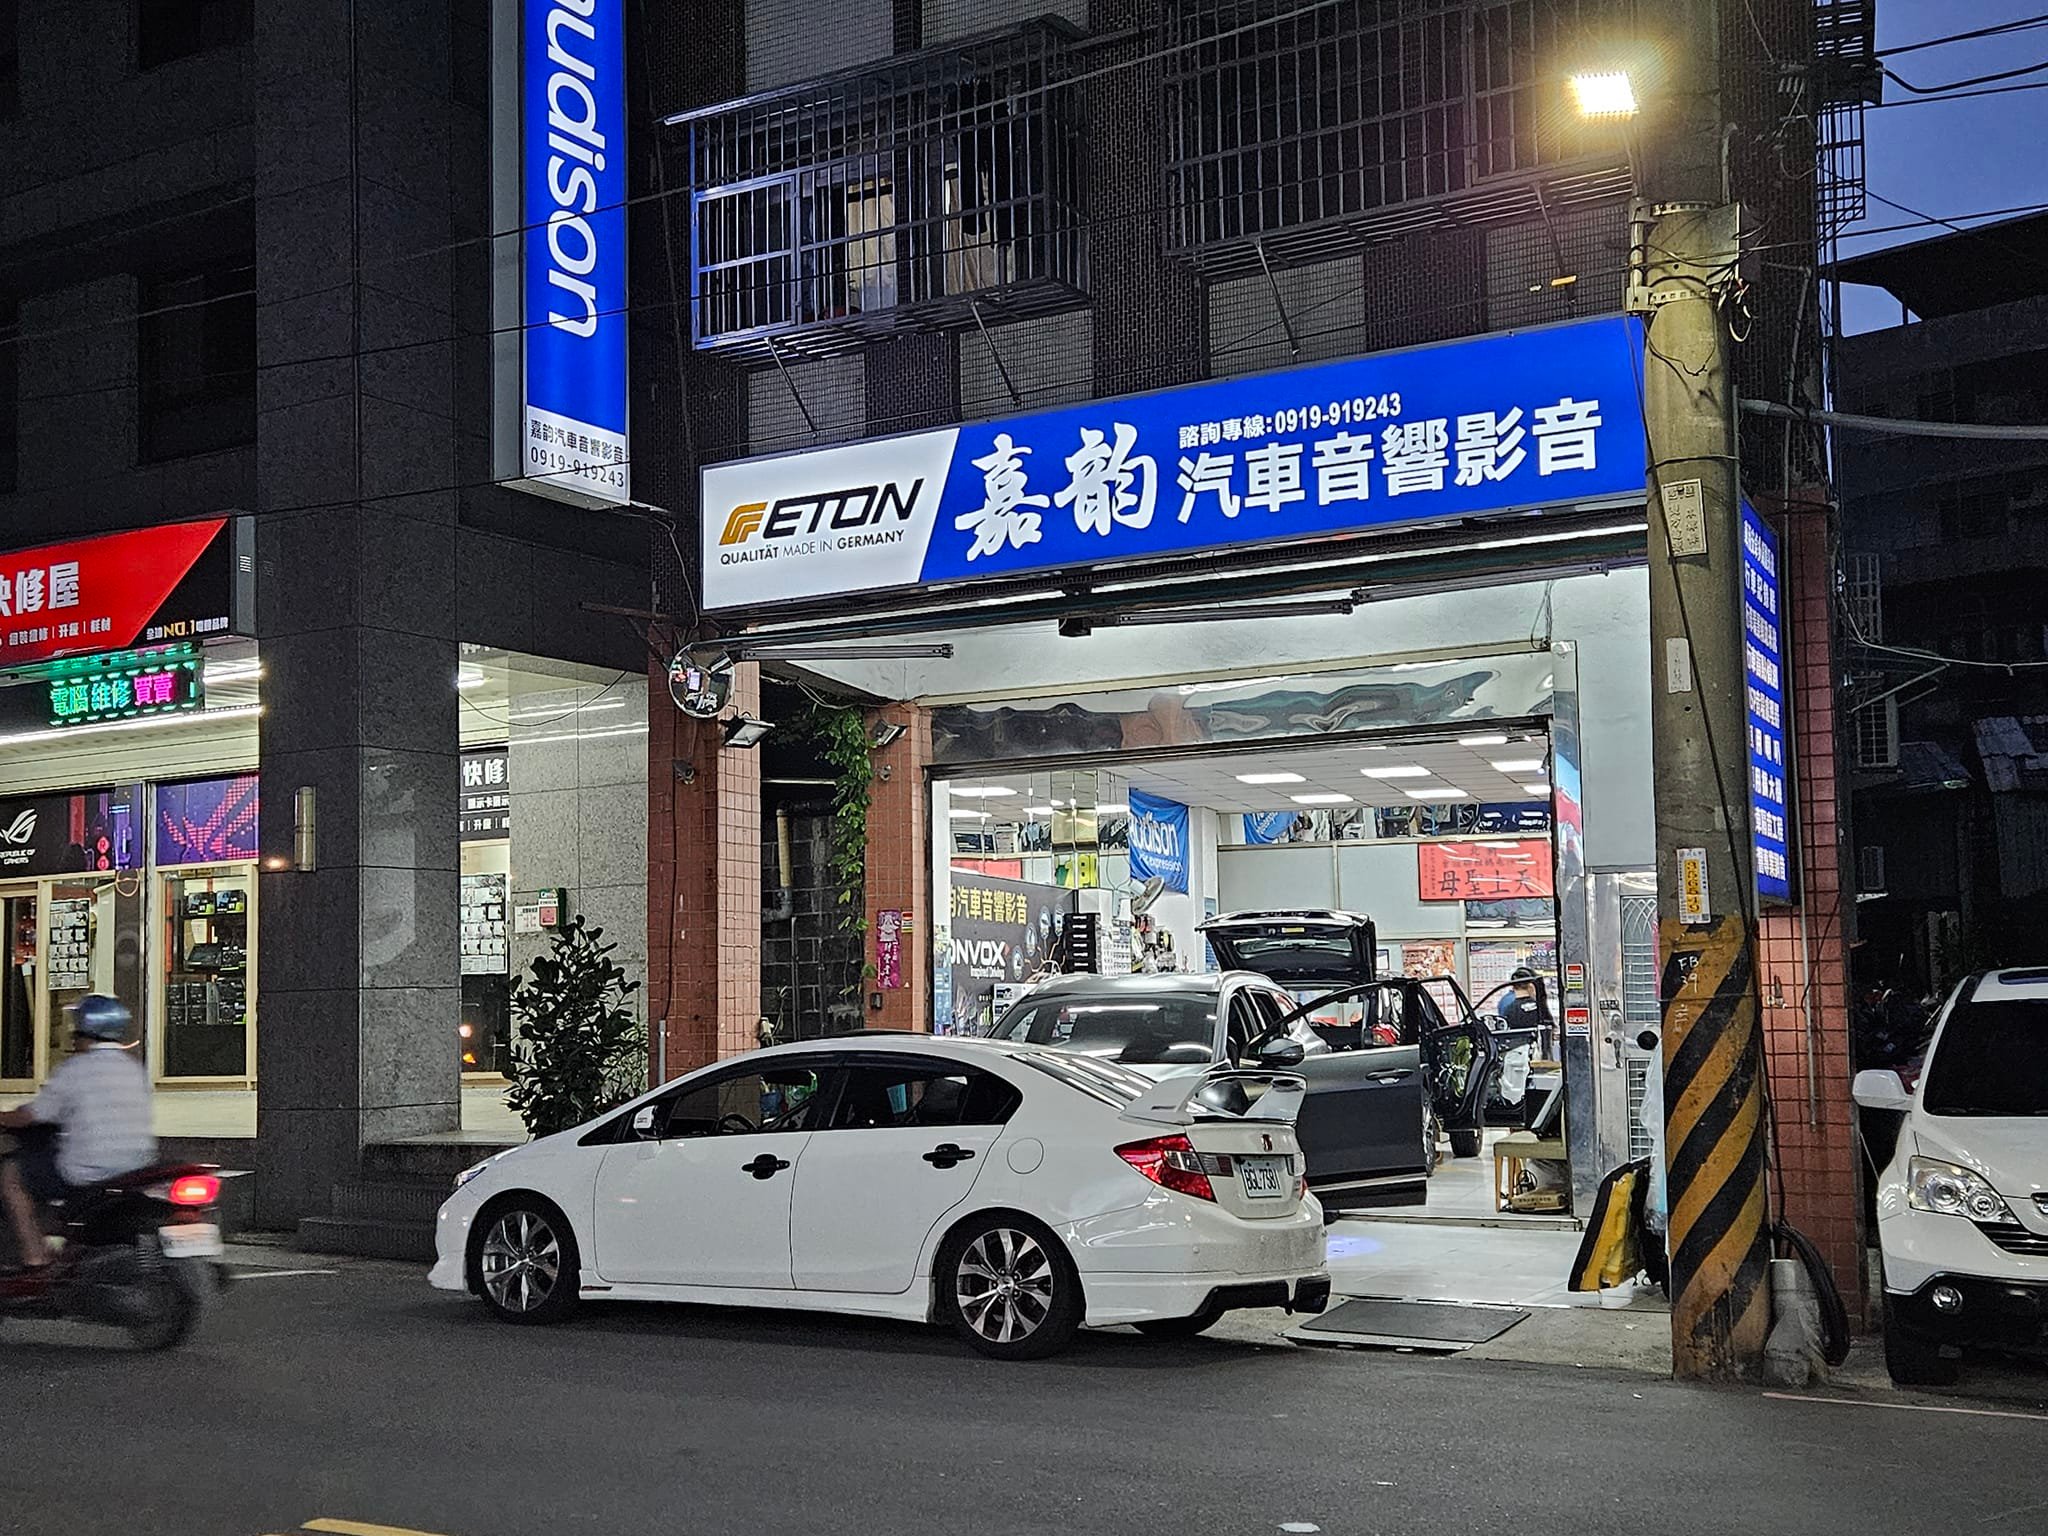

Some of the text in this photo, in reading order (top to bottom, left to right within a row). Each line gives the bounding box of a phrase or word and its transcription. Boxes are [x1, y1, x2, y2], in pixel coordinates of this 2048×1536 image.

[531, 456, 624, 488] 0919-919243
[1177, 397, 1602, 525] 汽車音響影音
[763, 478, 925, 540] ETON
[720, 530, 905, 566] QUALITÄT MADE IN GERMANY
[463, 758, 510, 787] 快修
